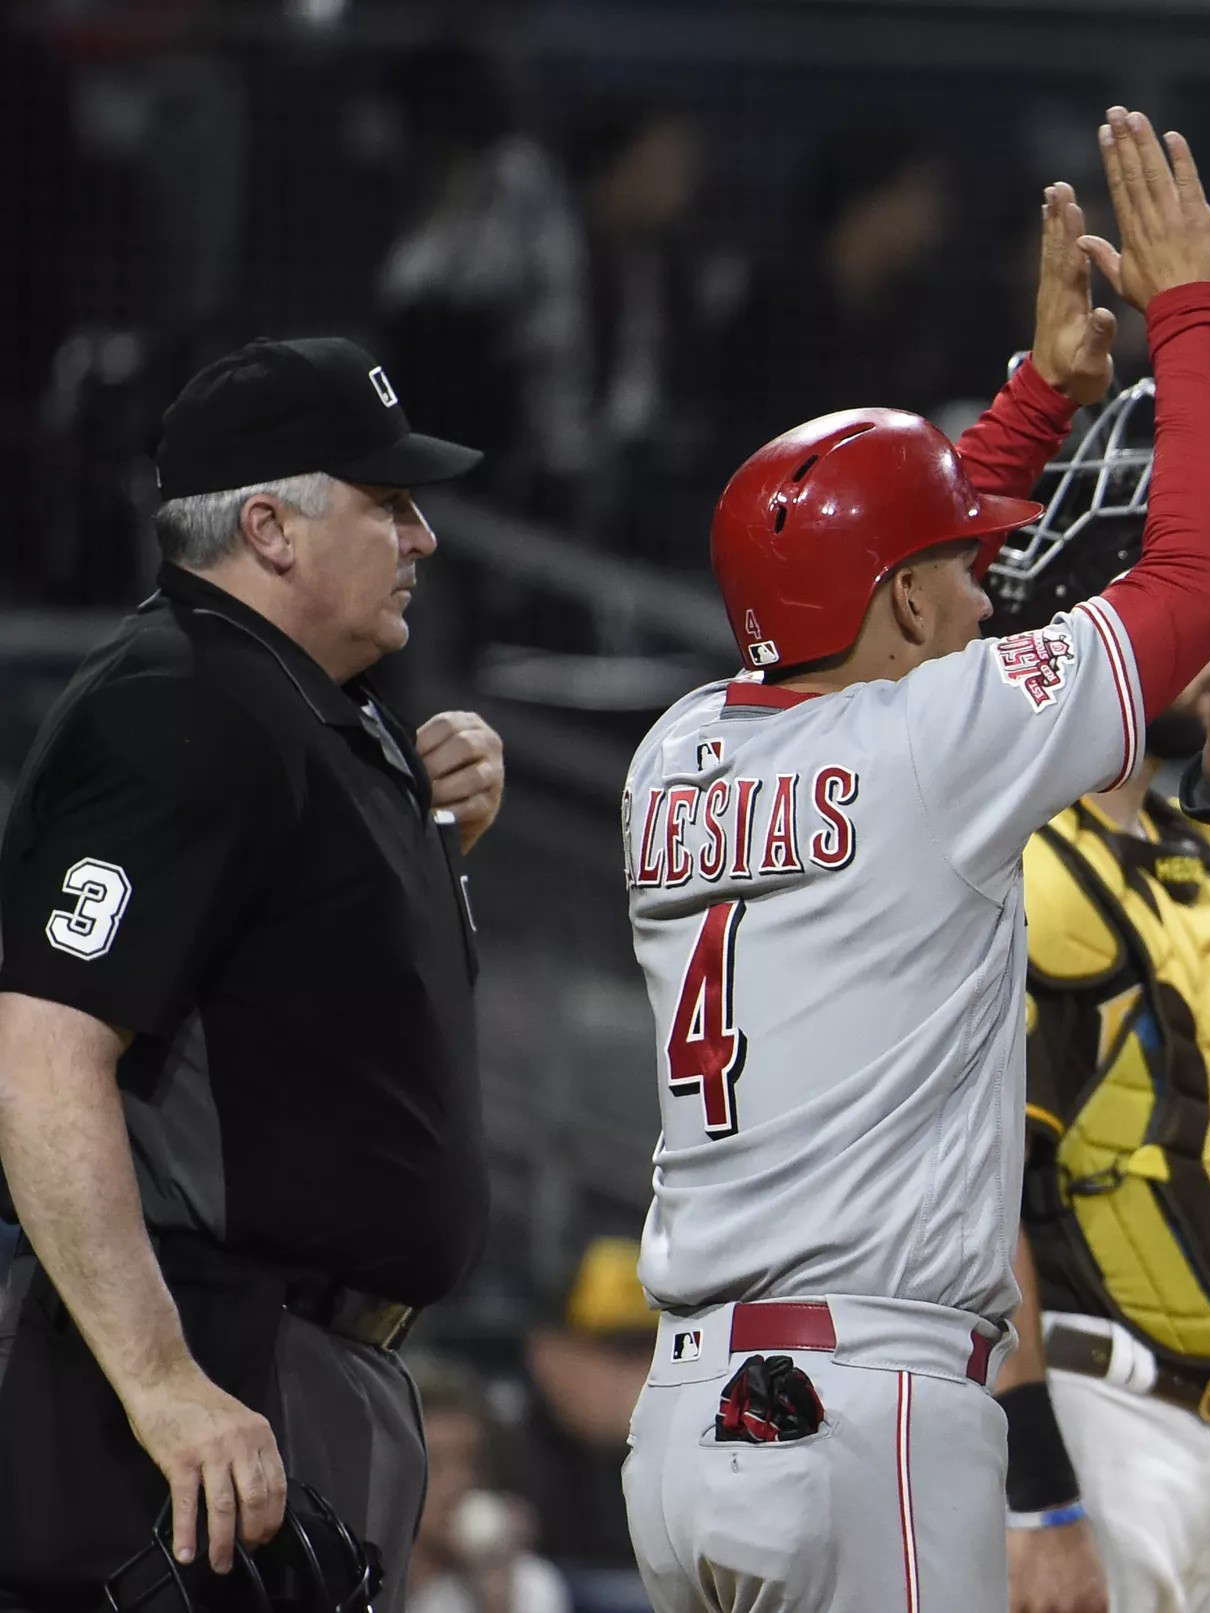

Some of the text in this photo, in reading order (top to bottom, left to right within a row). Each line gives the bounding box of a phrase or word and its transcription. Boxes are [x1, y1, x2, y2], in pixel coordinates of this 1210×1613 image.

[745, 608, 762, 640] 4
[622, 764, 858, 890] LESIAS
[45, 857, 132, 961] 3
[664, 898, 748, 1141] 4
